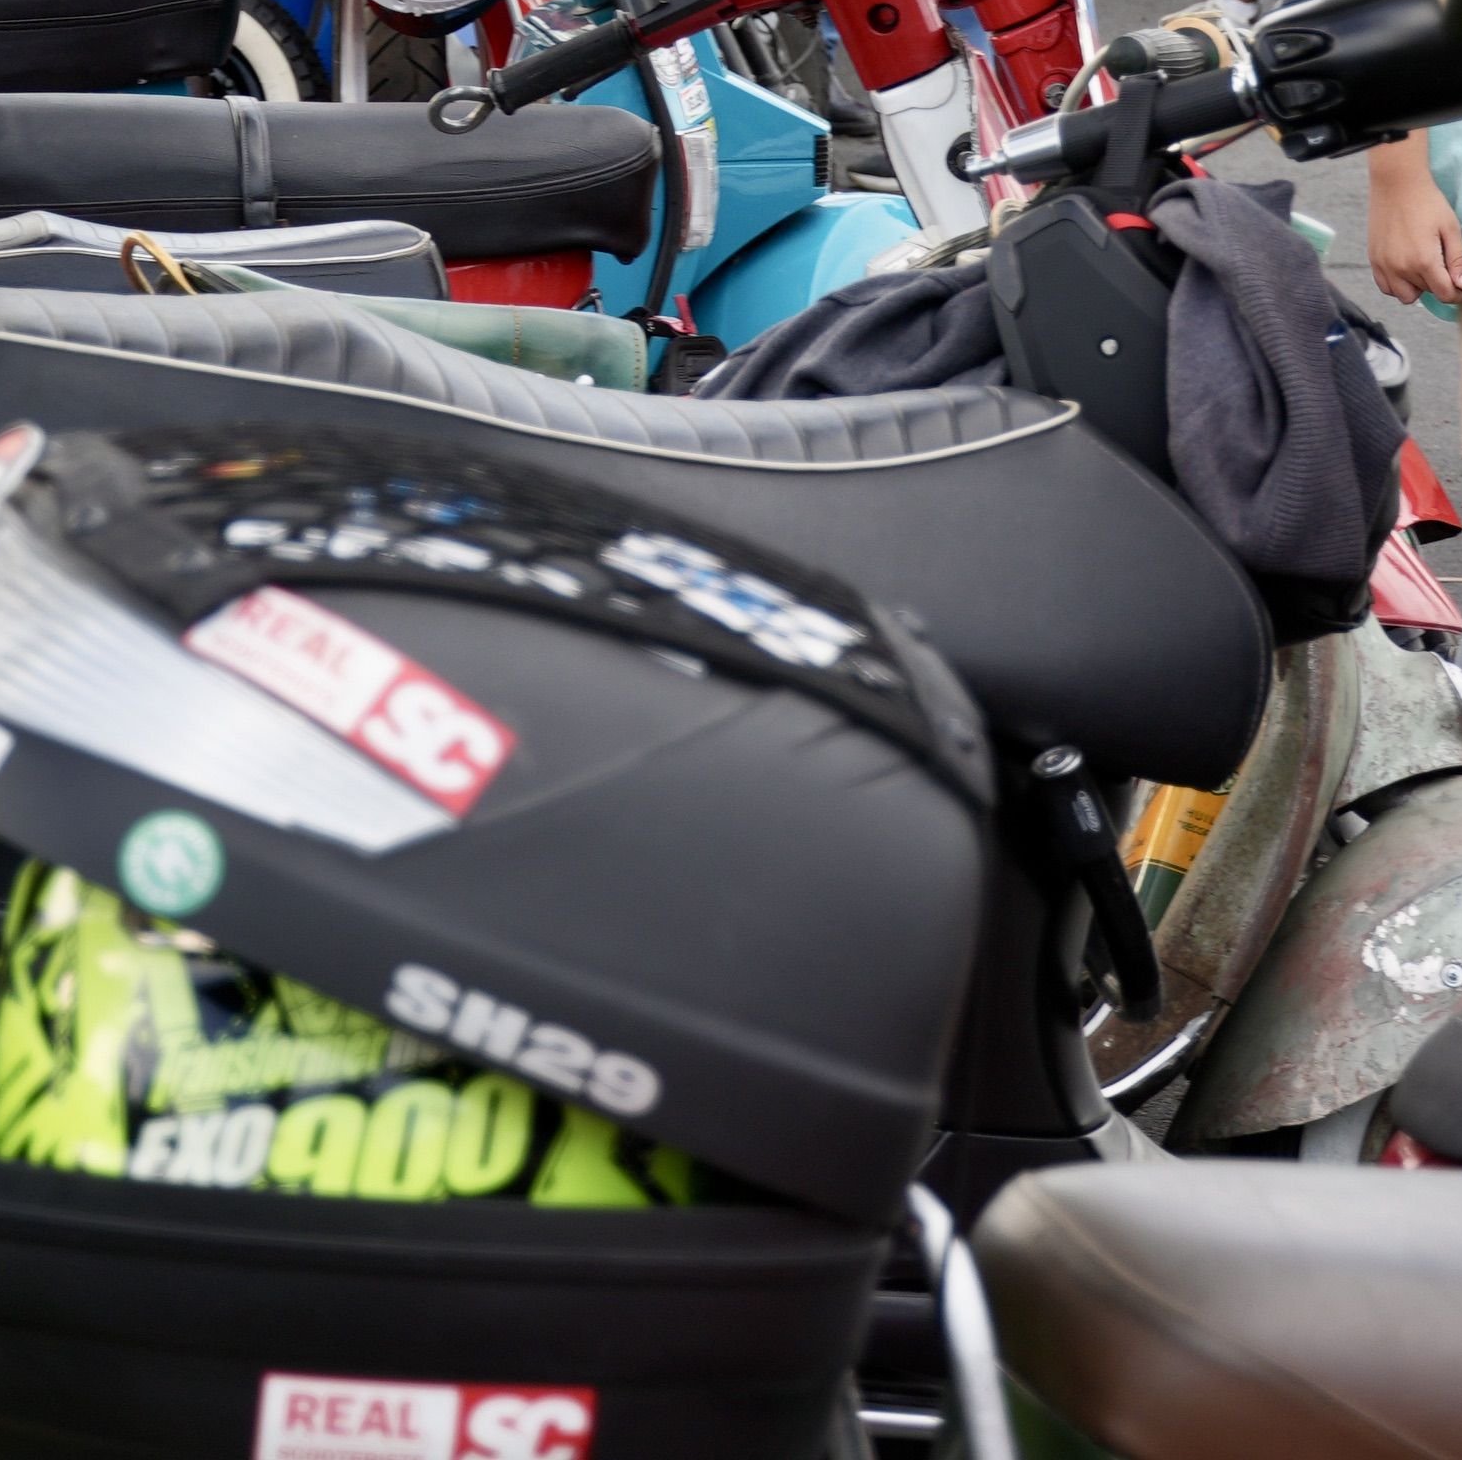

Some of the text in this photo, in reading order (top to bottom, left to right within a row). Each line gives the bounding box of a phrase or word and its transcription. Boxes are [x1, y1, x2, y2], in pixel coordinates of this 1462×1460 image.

[362, 680, 503, 794] SC
[385, 961, 663, 1118] SH29
[284, 1391, 589, 1460] REAL SC
